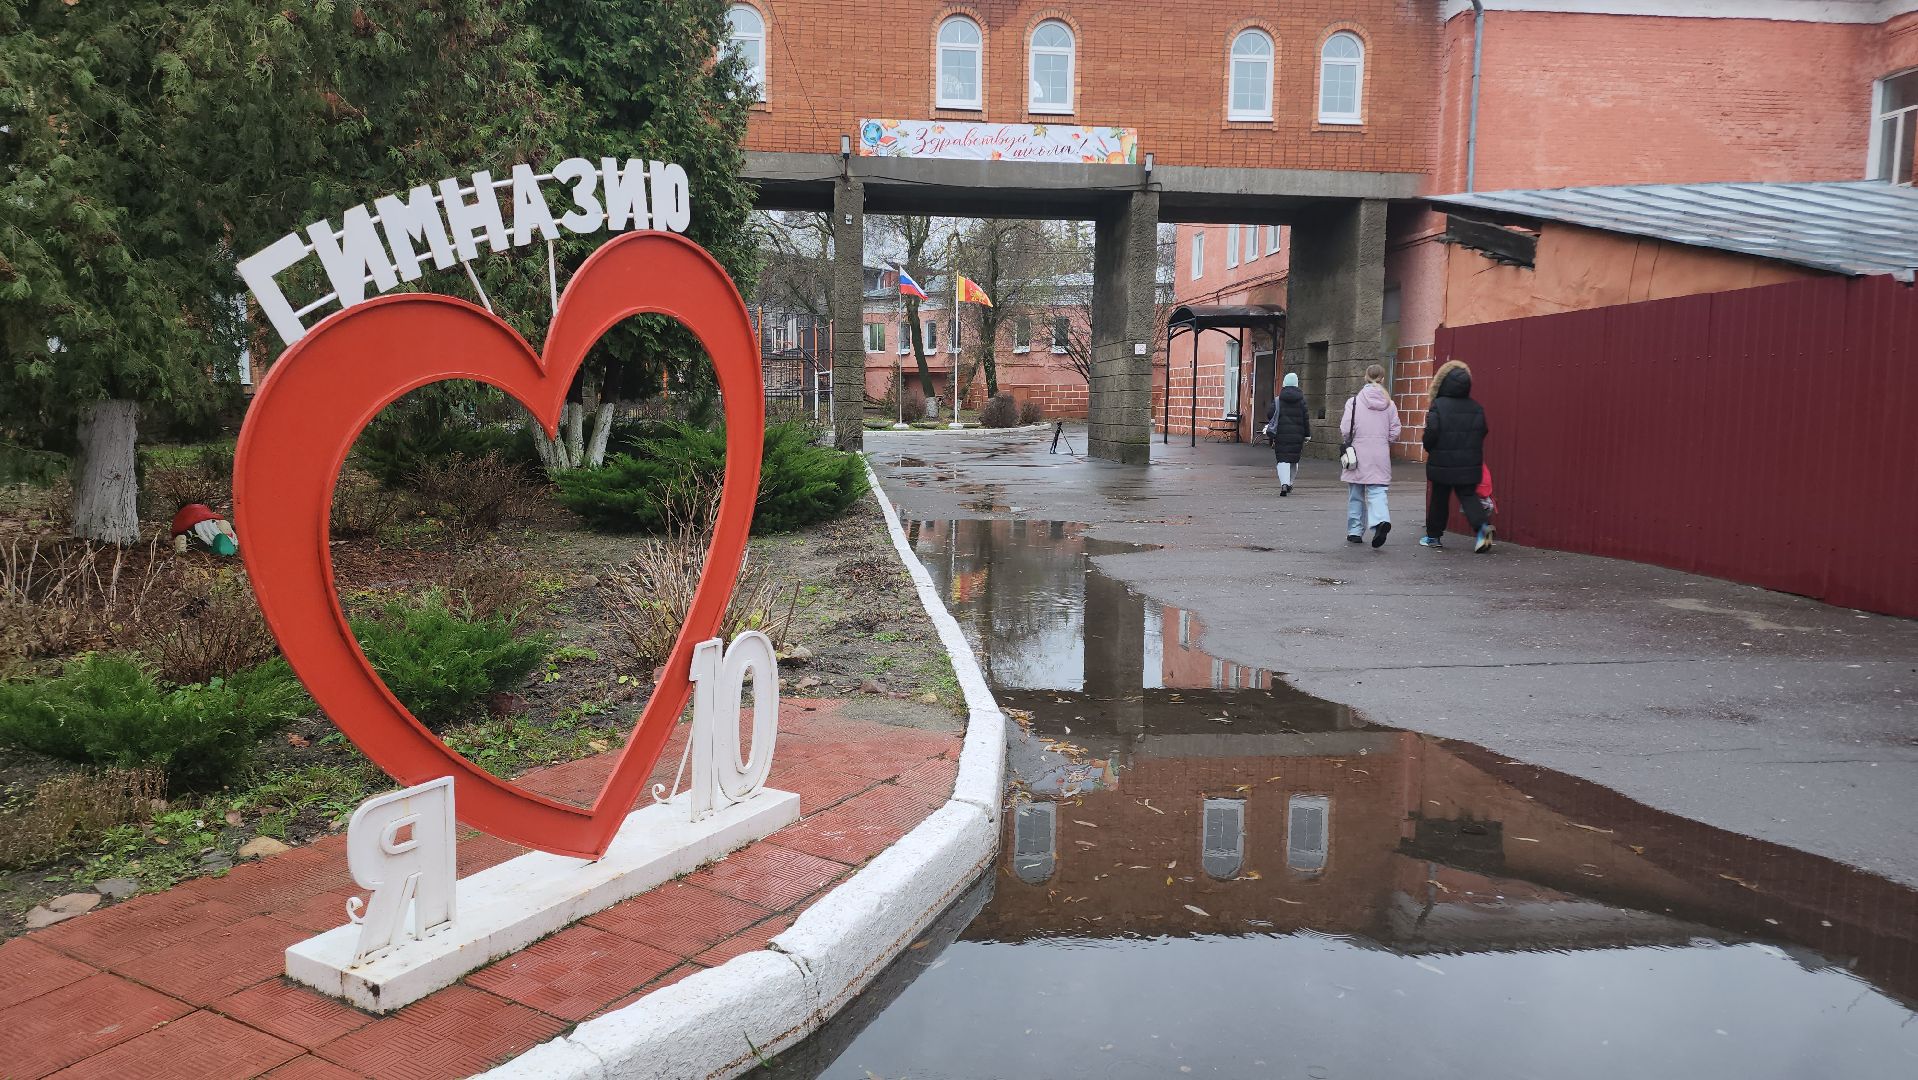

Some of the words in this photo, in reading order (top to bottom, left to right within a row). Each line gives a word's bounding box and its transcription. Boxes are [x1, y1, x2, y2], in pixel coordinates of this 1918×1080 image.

[1013, 138, 1088, 157] школа!
[237, 157, 690, 346] ГИМНАЗИЮ
[689, 630, 779, 822] 10
[347, 776, 456, 968] Я
